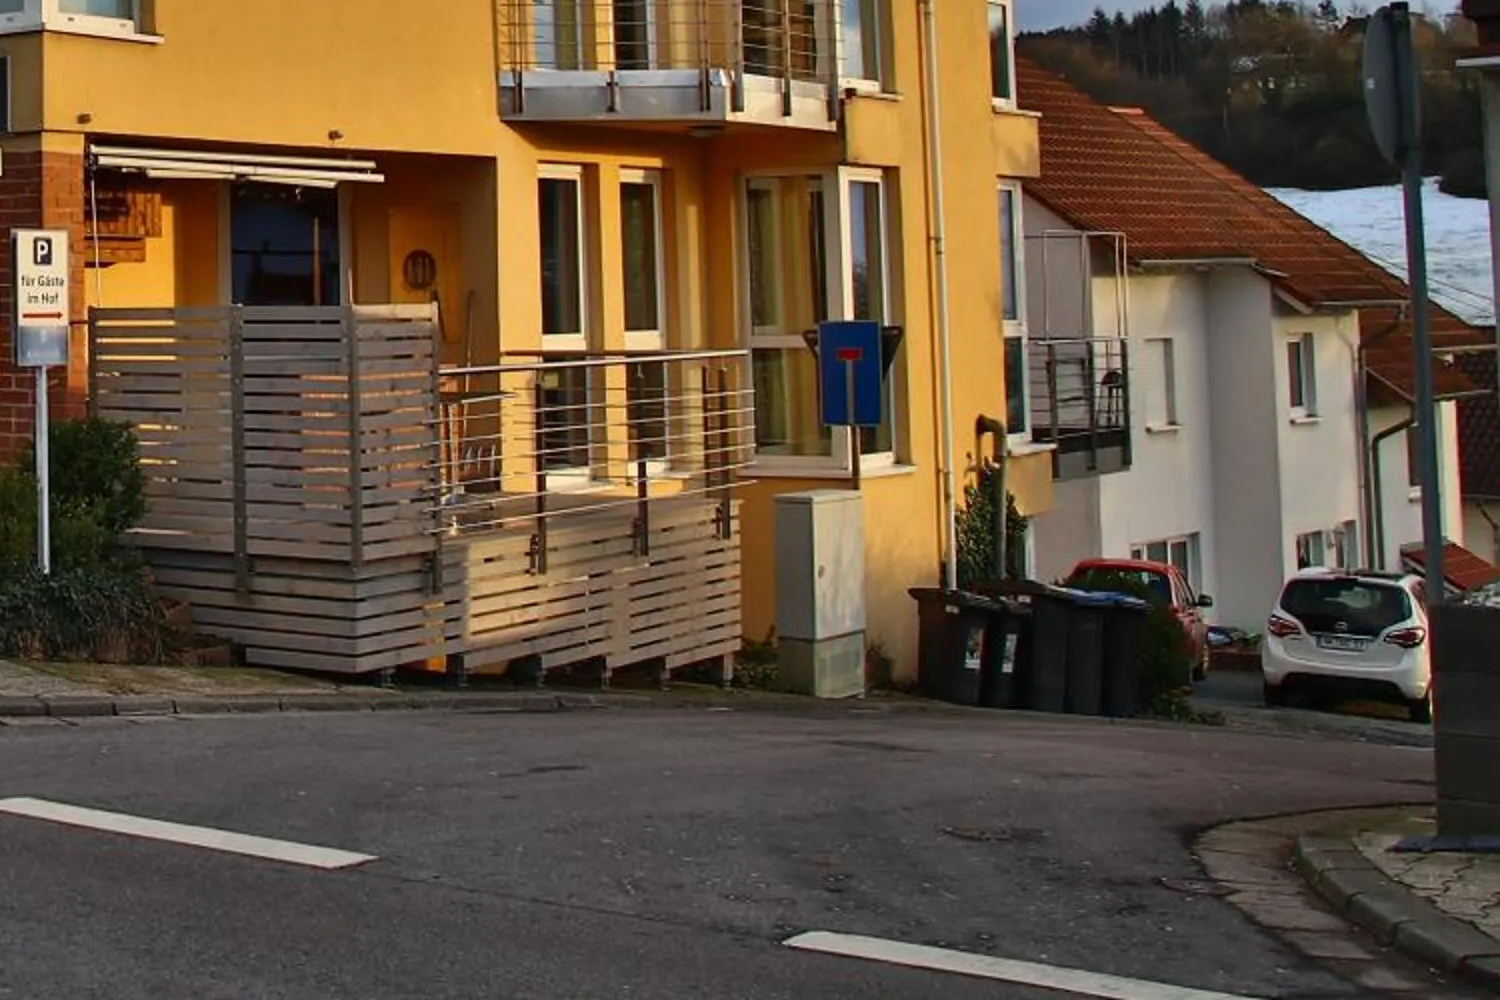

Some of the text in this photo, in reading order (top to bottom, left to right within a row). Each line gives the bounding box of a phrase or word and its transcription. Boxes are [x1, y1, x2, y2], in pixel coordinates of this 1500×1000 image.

[36, 240, 49, 263] P
[21, 274, 65, 288] für Gäste
[27, 292, 59, 304] im Hof
